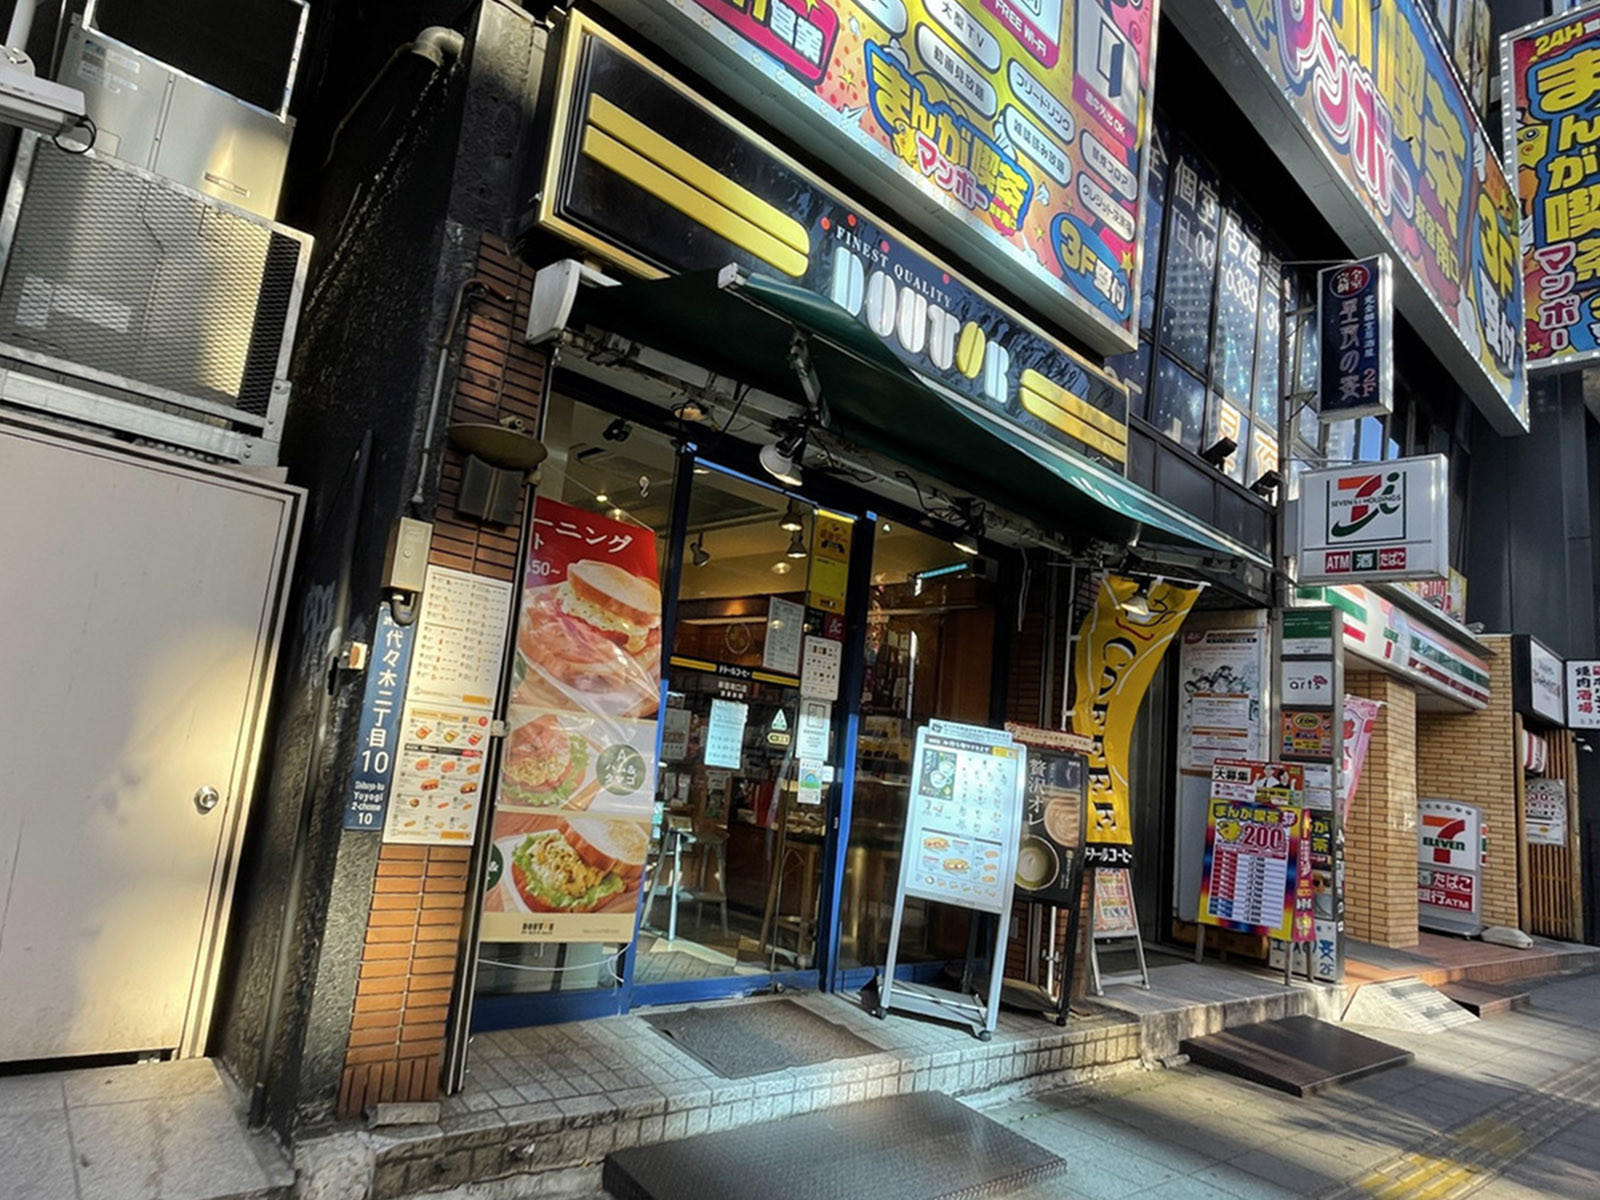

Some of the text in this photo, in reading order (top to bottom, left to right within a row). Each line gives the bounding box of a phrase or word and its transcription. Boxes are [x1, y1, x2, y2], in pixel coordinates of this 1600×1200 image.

[941, 2, 985, 47] 大型TV
[1535, 22, 1583, 57] 24H
[916, 132, 989, 209] マンボー
[837, 225, 952, 309] FINEST QUALITY
[1060, 218, 1127, 312] 3F受付
[1536, 242, 1578, 350] マンボー
[832, 246, 1010, 403] DOUTOR
[1361, 368, 1377, 398] 2F
[1326, 555, 1350, 570] ATM
[369, 629, 404, 748] 代々木二丁目
[1289, 679, 1321, 690] arts
[361, 750, 390, 774] 10
[353, 791, 383, 803] Yoyogi
[358, 812, 373, 825] 10
[1243, 824, 1283, 850] 200
[1433, 872, 1472, 893] たばこ
